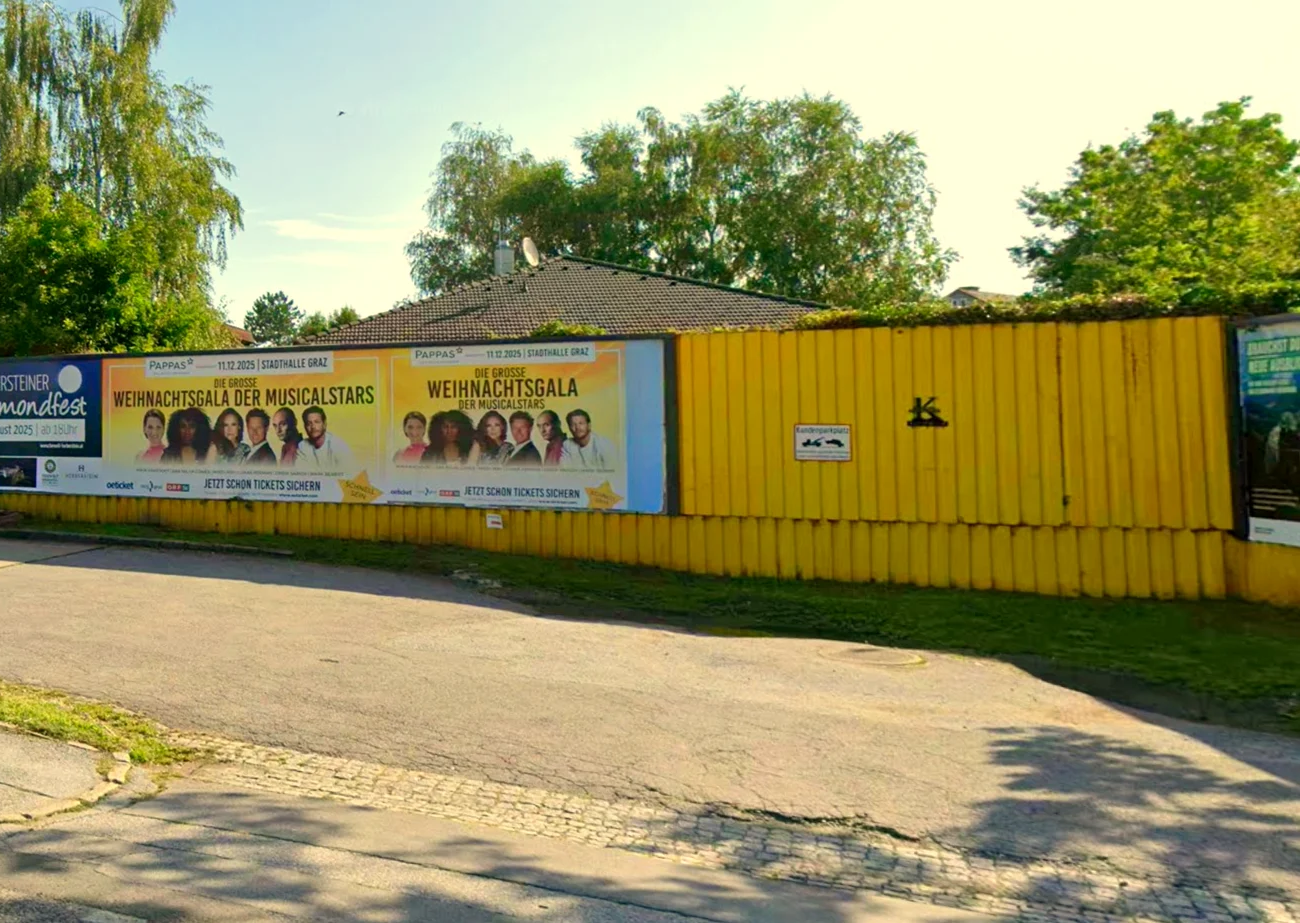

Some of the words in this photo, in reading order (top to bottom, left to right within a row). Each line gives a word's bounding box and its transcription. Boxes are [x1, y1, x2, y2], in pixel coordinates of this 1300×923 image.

[415, 349, 455, 359] PAPPAS
[486, 349, 522, 360] 11.12.2025
[527, 348, 568, 358] STADTHALLE
[570, 346, 589, 356] GRAZ
[149, 360, 187, 370] PAPPAS
[217, 360, 256, 371] 11.12.2025
[261, 359, 306, 370] STADTHALLE
[308, 358, 328, 368] GRAZ
[475, 368, 489, 379] DIE
[492, 367, 526, 378] GROSSE
[214, 378, 226, 388] DIE
[228, 378, 258, 388] GROSSE
[428, 378, 578, 398] WEIHNACHTSGALA
[114, 390, 230, 408] WEIHNACHTSGALA
[234, 389, 260, 407] DER
[266, 386, 375, 406] MUSICALSTARS
[458, 399, 476, 410] DER
[478, 398, 545, 410] MUSICALSTARS
[13, 424, 33, 436] 2025
[41, 424, 51, 436] ab
[204, 478, 224, 489] JETZT
[226, 479, 252, 490] SCHON
[254, 479, 286, 491] TICKETS
[286, 480, 321, 492] SICHERN
[464, 486, 484, 496] JETZT
[486, 486, 512, 496] SCHON
[514, 488, 544, 498] TICKETS
[546, 488, 580, 498] SICHERN
